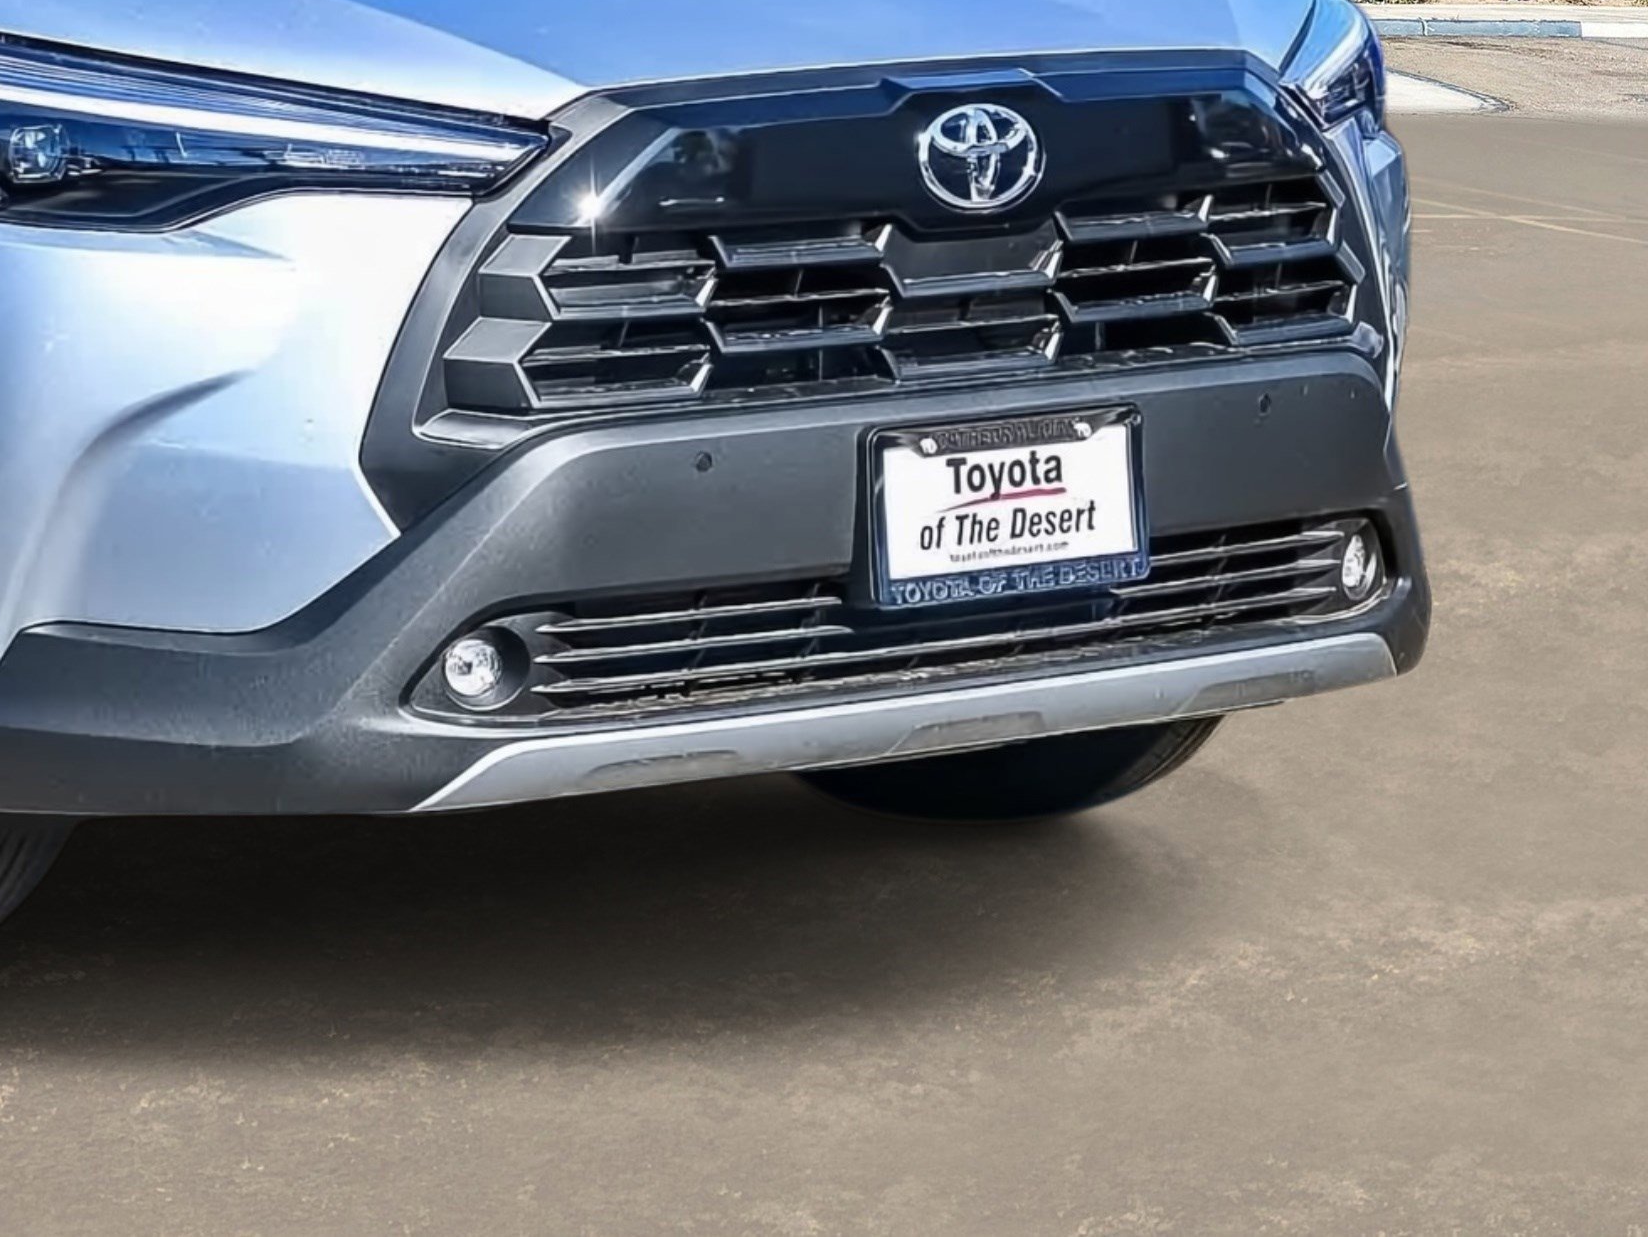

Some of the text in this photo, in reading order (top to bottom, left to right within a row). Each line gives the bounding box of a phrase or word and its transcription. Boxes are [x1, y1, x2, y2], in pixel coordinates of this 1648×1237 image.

[946, 450, 1063, 500] Toyota
[919, 500, 1096, 551] of The Desert
[891, 577, 976, 605] TOYOTA
[1012, 566, 1055, 591] THE
